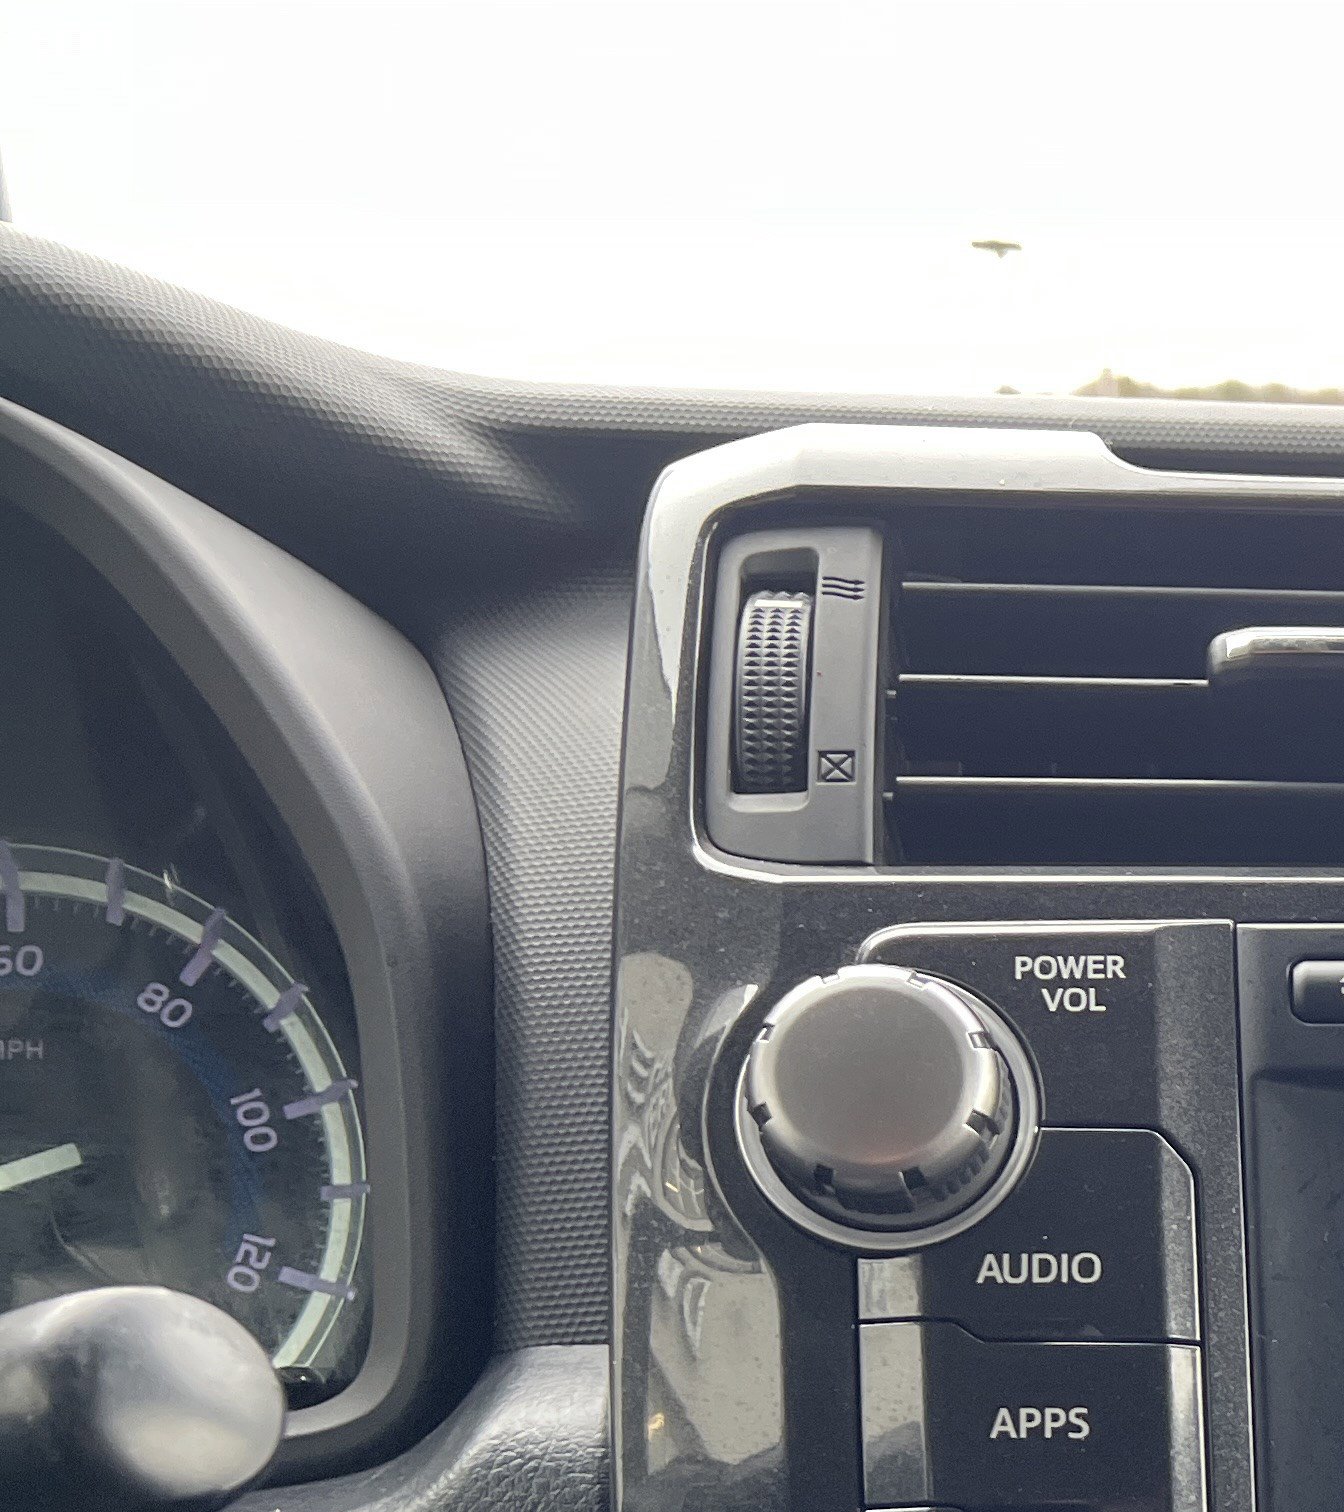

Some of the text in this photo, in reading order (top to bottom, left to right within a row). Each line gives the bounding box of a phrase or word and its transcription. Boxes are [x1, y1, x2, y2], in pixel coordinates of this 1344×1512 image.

[1014, 955, 1125, 981] POWER
[136, 981, 194, 1029] 80
[1041, 986, 1106, 1012] VOL
[0, 1037, 44, 1060] PH
[230, 1087, 279, 1153] 100
[226, 1233, 277, 1293] 120
[976, 1251, 1103, 1286] AUDIO
[989, 1408, 1091, 1441] APPS
